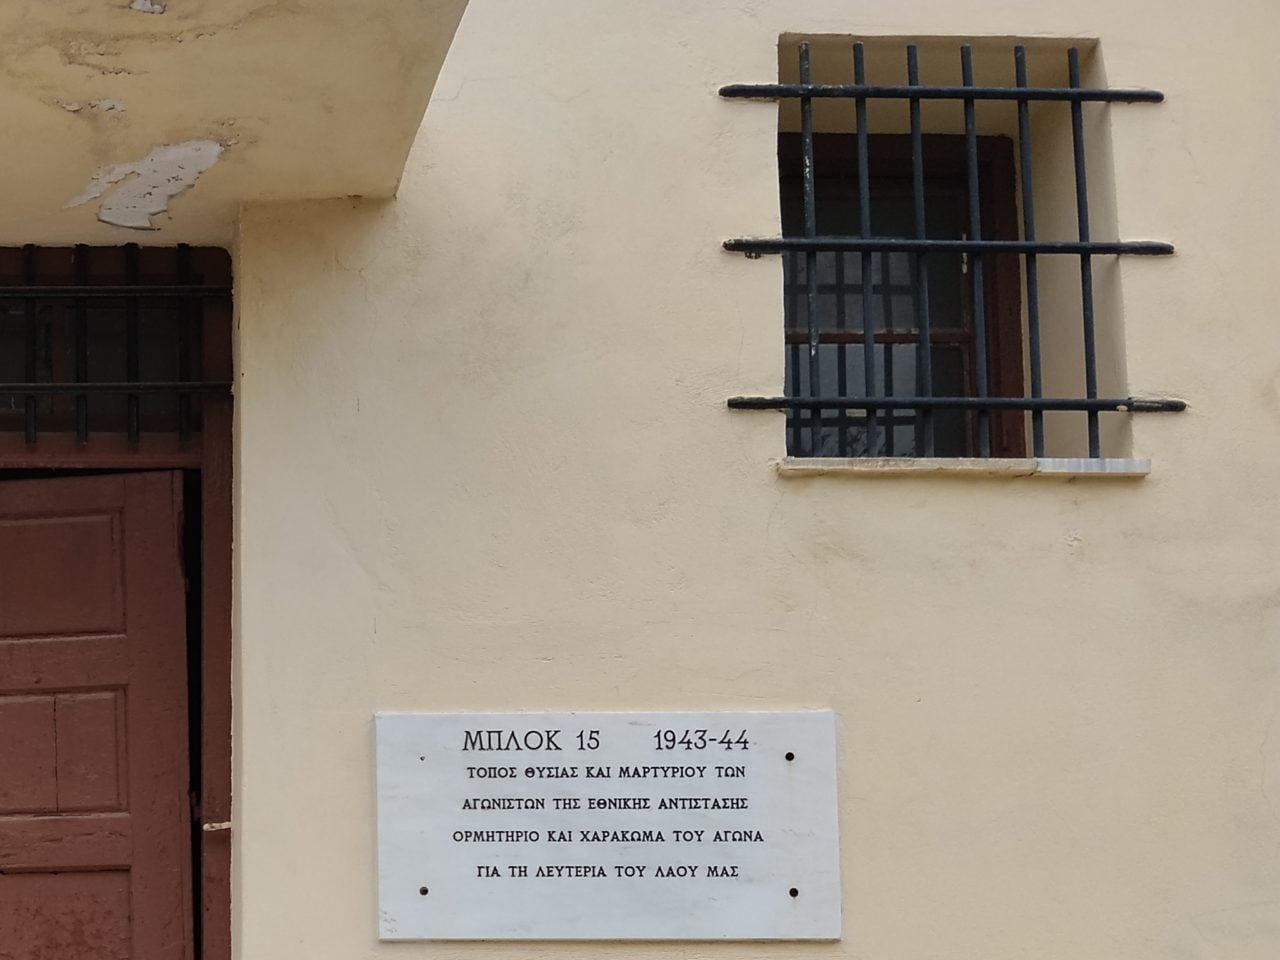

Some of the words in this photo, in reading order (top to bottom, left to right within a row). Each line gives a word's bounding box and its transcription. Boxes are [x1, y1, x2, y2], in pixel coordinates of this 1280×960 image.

[461, 730, 563, 751] ΜΠΛΟΚ
[575, 730, 601, 750] 15
[653, 729, 750, 750] 1943-44
[466, 767, 517, 778] ΤΟΠΟΣ
[524, 767, 579, 778] ΘΥΣΙΑΣ
[585, 767, 611, 778] ΚΑΙ
[618, 766, 707, 778] ΜΑΡΤΥΡΙΟΥ
[715, 766, 746, 778] ΤΩΝ
[461, 798, 545, 810] ΑΓΩΝΙΣΤΩΝ
[553, 798, 581, 809] ΤΗΣ
[588, 798, 651, 809] ΕΘΝΙΚΗΣ
[658, 798, 749, 809] ΑΝΤΙΣΤΑΣΗΣ
[452, 831, 540, 842] ΟΡΜΗΤΗΡΙΟ
[547, 831, 573, 842] ΚΑΙ
[580, 831, 665, 842] ΧΑΡΑΚΩΜΑ
[673, 830, 704, 842] ΤΟΥ
[713, 831, 765, 842] ΑΓΩΝΑ
[476, 866, 501, 877] ΓΙΑ
[508, 866, 528, 877] ΤΗ
[535, 866, 607, 877] ΛΕΥΤΕΡΙΑ
[615, 866, 646, 877] ΤΟΥ
[655, 866, 699, 877] ΛΑΟΥ
[706, 866, 739, 877] ΜΑΣ
